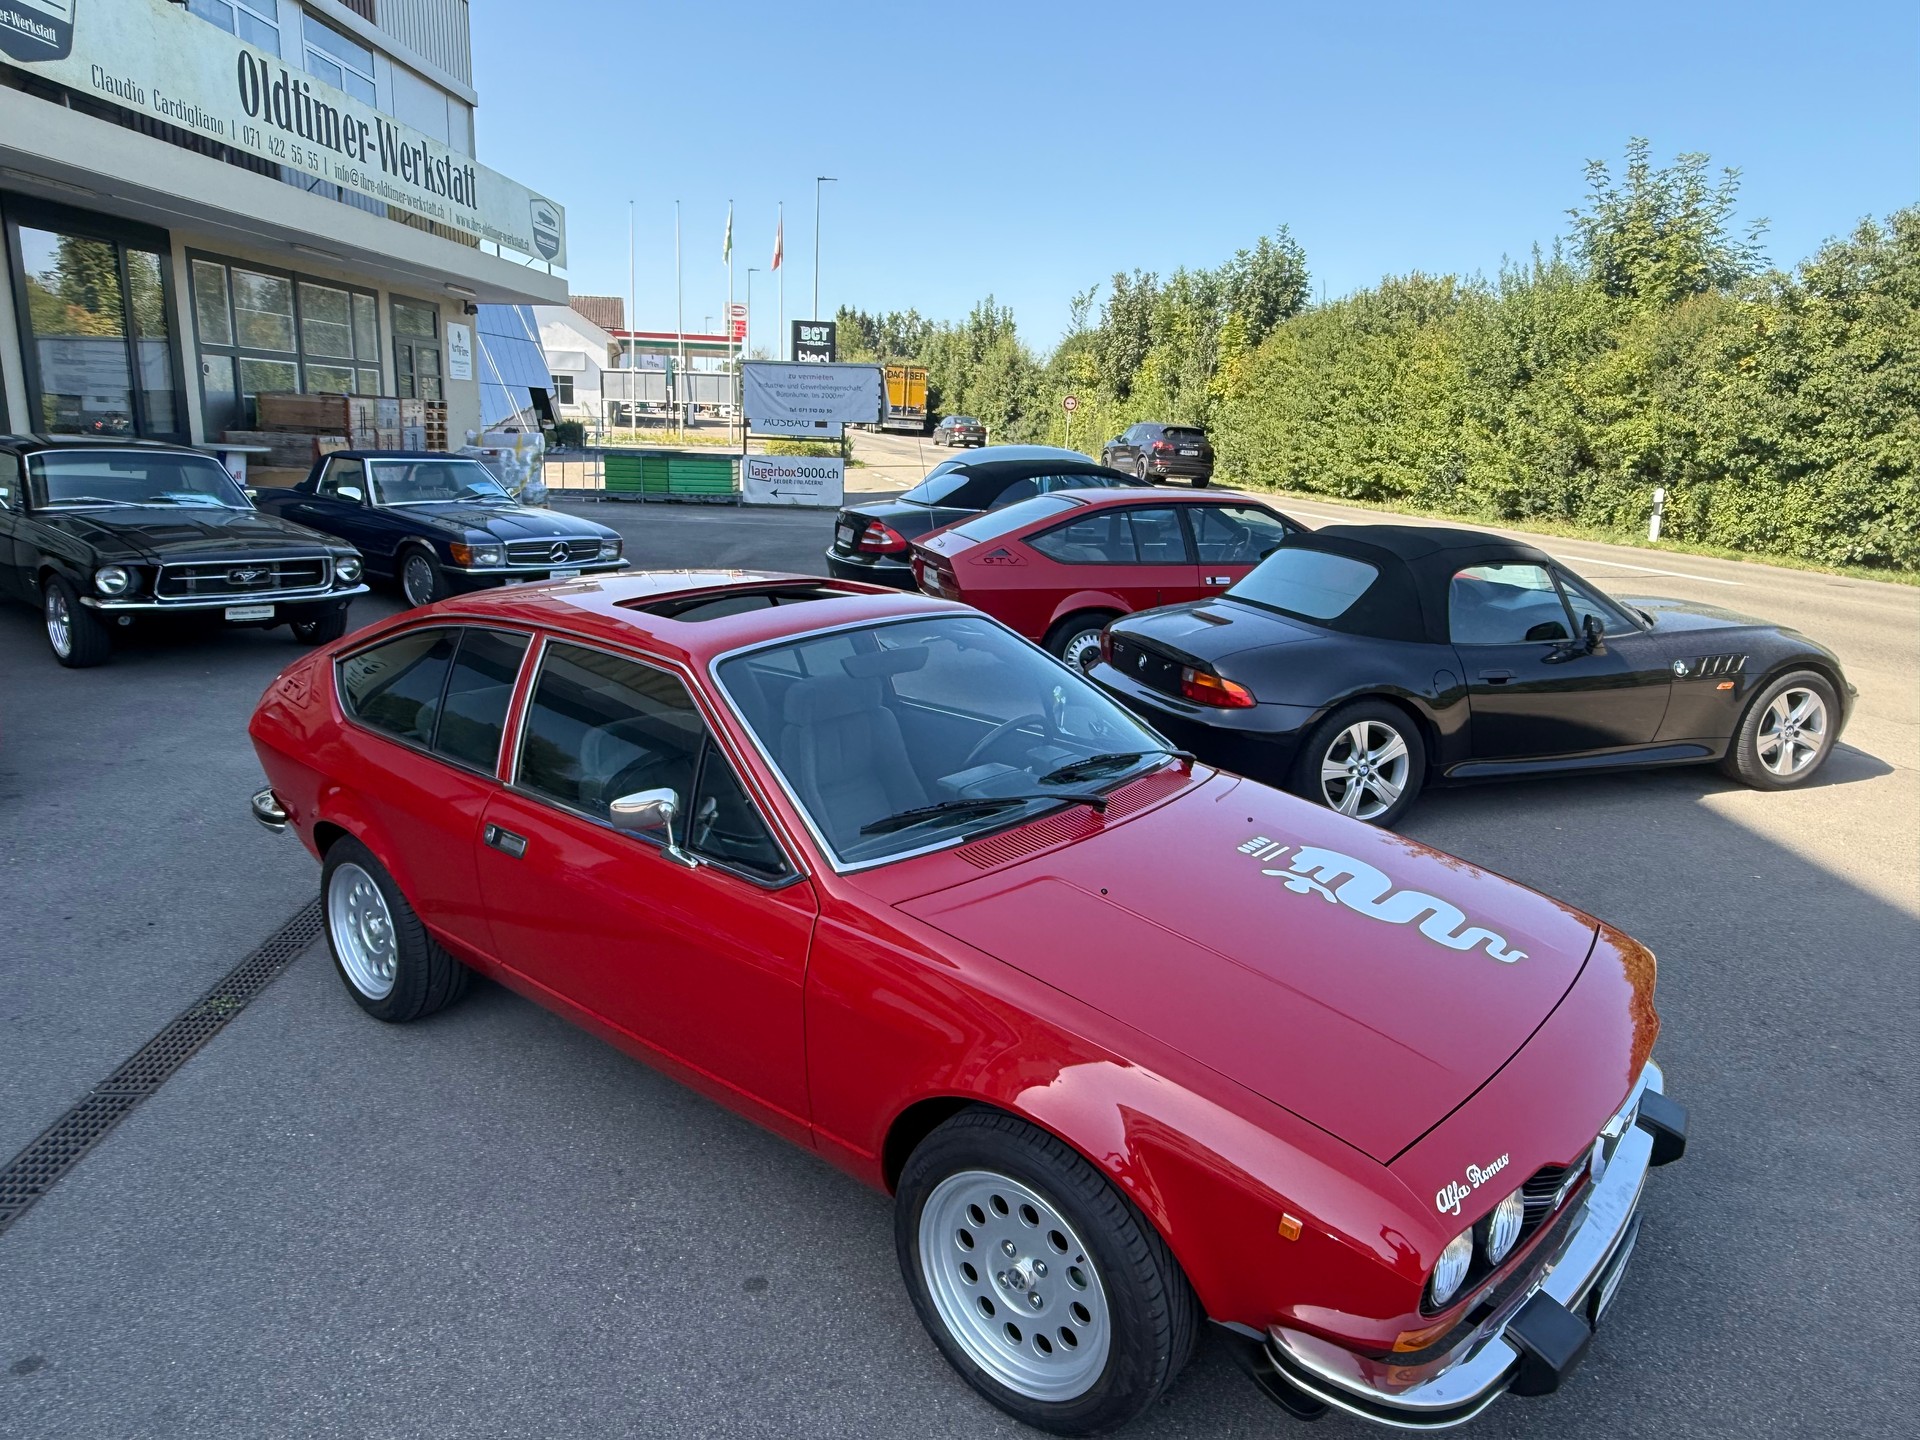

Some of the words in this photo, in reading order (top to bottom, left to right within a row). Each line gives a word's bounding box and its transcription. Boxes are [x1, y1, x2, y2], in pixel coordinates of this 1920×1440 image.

[91, 64, 145, 105] Claudio
[153, 88, 224, 136] Cardigliano
[243, 126, 261, 150] 071
[268, 135, 286, 159] 422
[291, 144, 303, 165] 55
[307, 151, 319, 172] 55
[334, 162, 445, 219] info@ihre-oldtimer-werkstatt.ch
[238, 50, 477, 211] Oldtimer-Werkstatt
[800, 326, 829, 340] BCT
[751, 465, 839, 479] lagerbox9000.ch
[983, 557, 1020, 565] GTV
[1436, 1181, 1470, 1215] Alfa
[1466, 1153, 1509, 1188] Romeo
